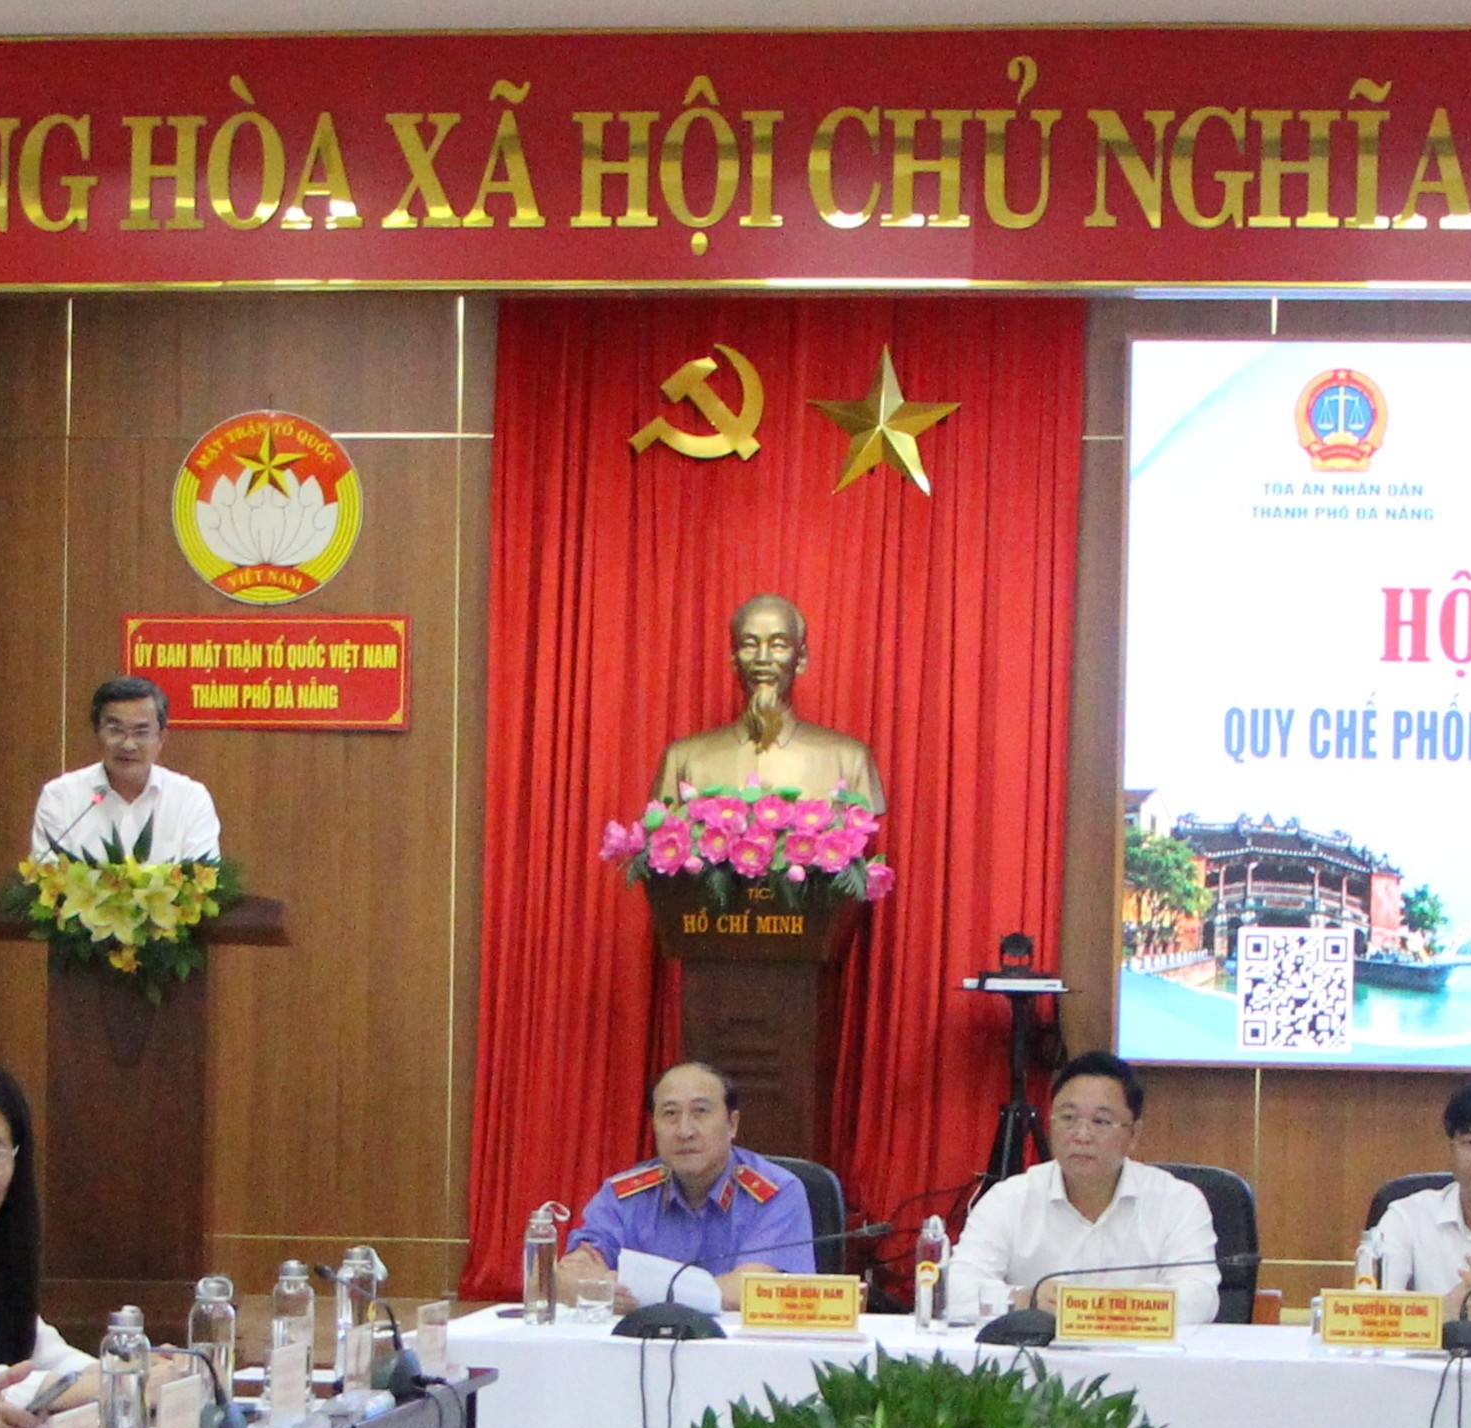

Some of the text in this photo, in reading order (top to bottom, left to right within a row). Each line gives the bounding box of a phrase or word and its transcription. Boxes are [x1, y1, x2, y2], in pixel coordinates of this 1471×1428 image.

[120, 75, 363, 232] HÒA
[382, 79, 545, 229] XÃ
[570, 75, 784, 257] HỘI
[808, 55, 1061, 230] CHỦ
[268, 570, 303, 590] NAM
[157, 643, 187, 668] BAN
[287, 635, 326, 671] QUỐC
[329, 639, 360, 673] VIỆT
[363, 644, 398, 669] NAM
[191, 679, 239, 709] THÀNH
[242, 676, 272, 709] PHỐ
[274, 680, 294, 709] ĐÀ
[1223, 707, 1296, 763] QUY
[1308, 692, 1378, 761] CHẾ
[746, 887, 775, 904] TỊC
[716, 909, 751, 934] CHÍ
[756, 914, 804, 934] MINH
